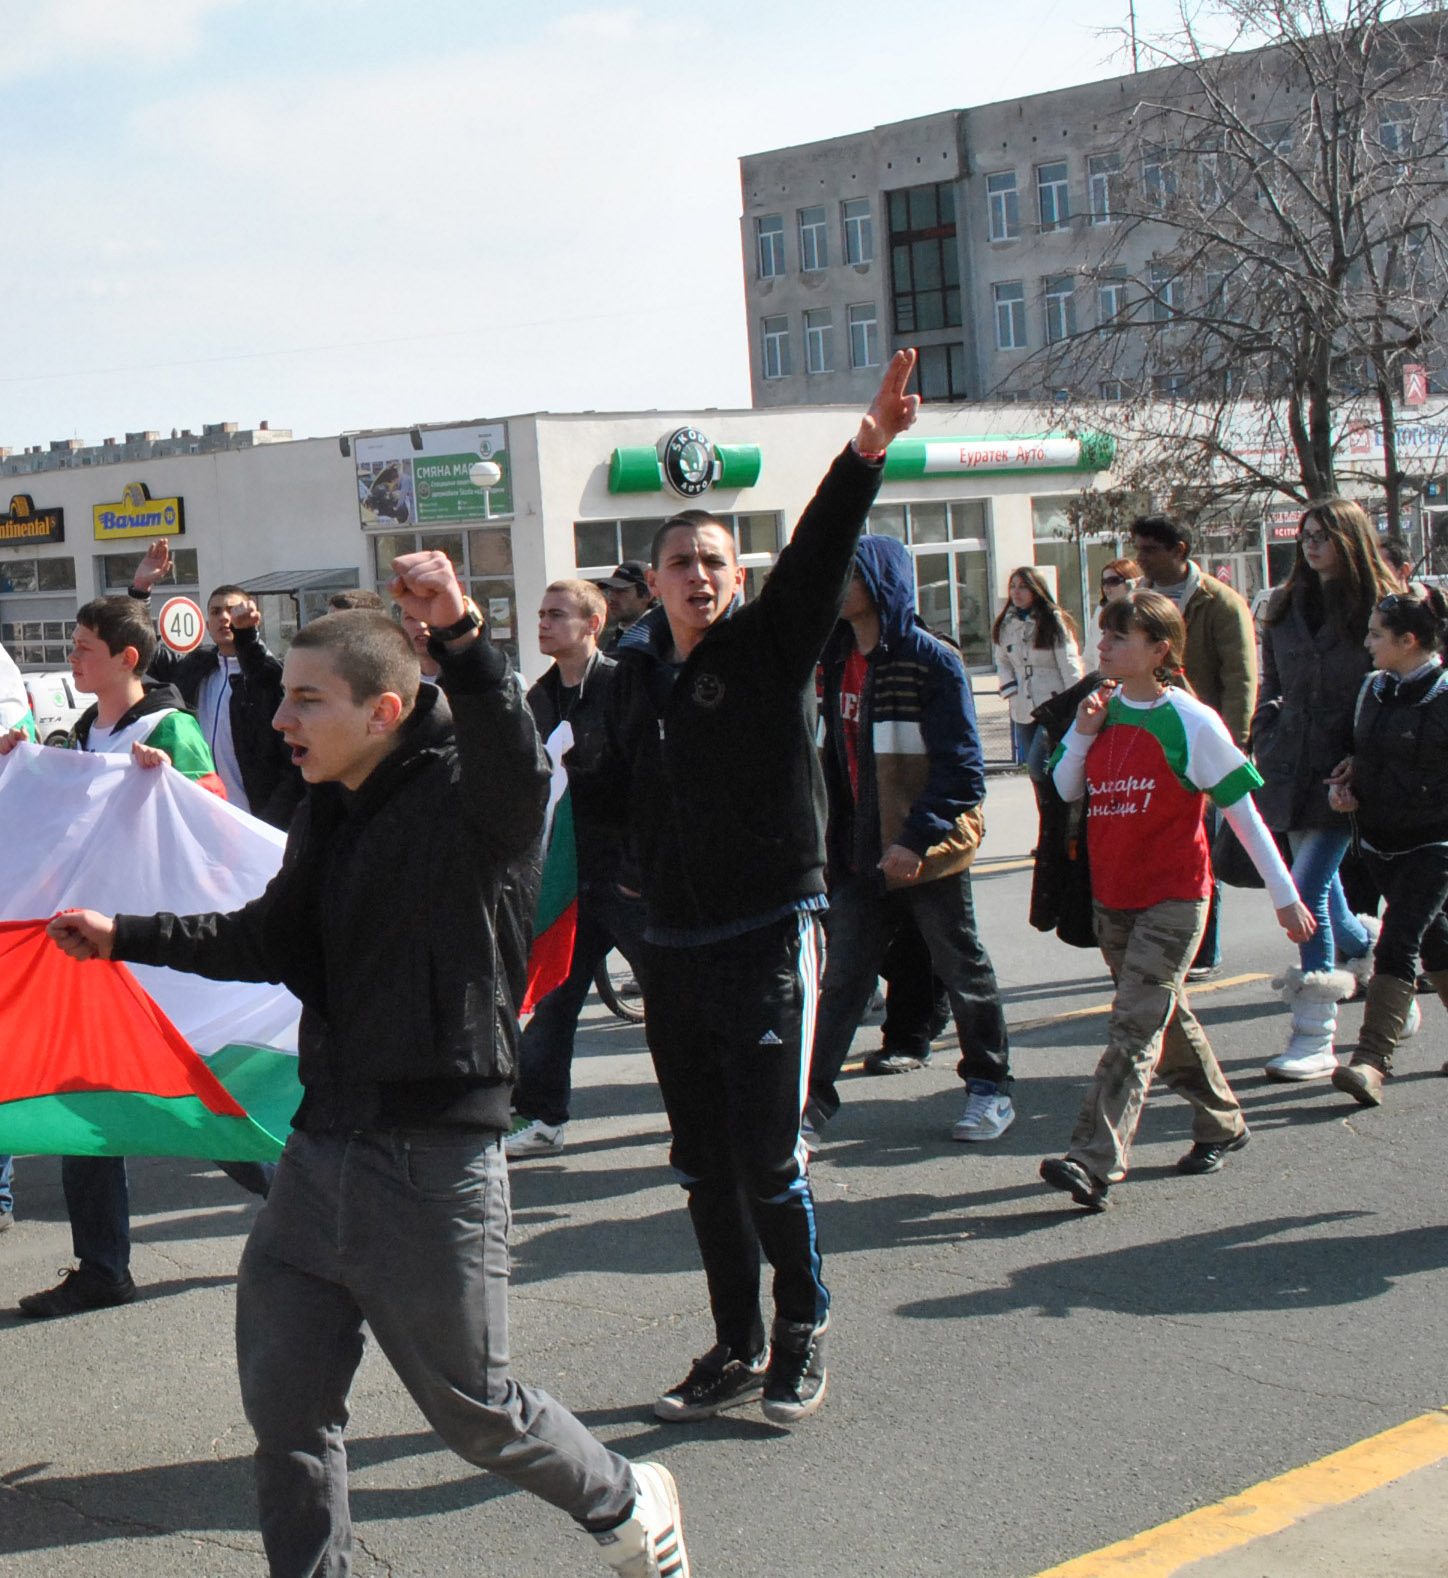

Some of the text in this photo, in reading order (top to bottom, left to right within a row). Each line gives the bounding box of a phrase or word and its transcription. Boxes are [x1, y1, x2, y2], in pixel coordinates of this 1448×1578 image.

[959, 445, 1046, 467] Еуратек Ауто
[416, 464, 451, 479] СМЯНА
[681, 480, 708, 493] AUTO
[100, 511, 161, 530] Barum
[170, 612, 194, 637] 40
[1086, 775, 1156, 798] ългари
